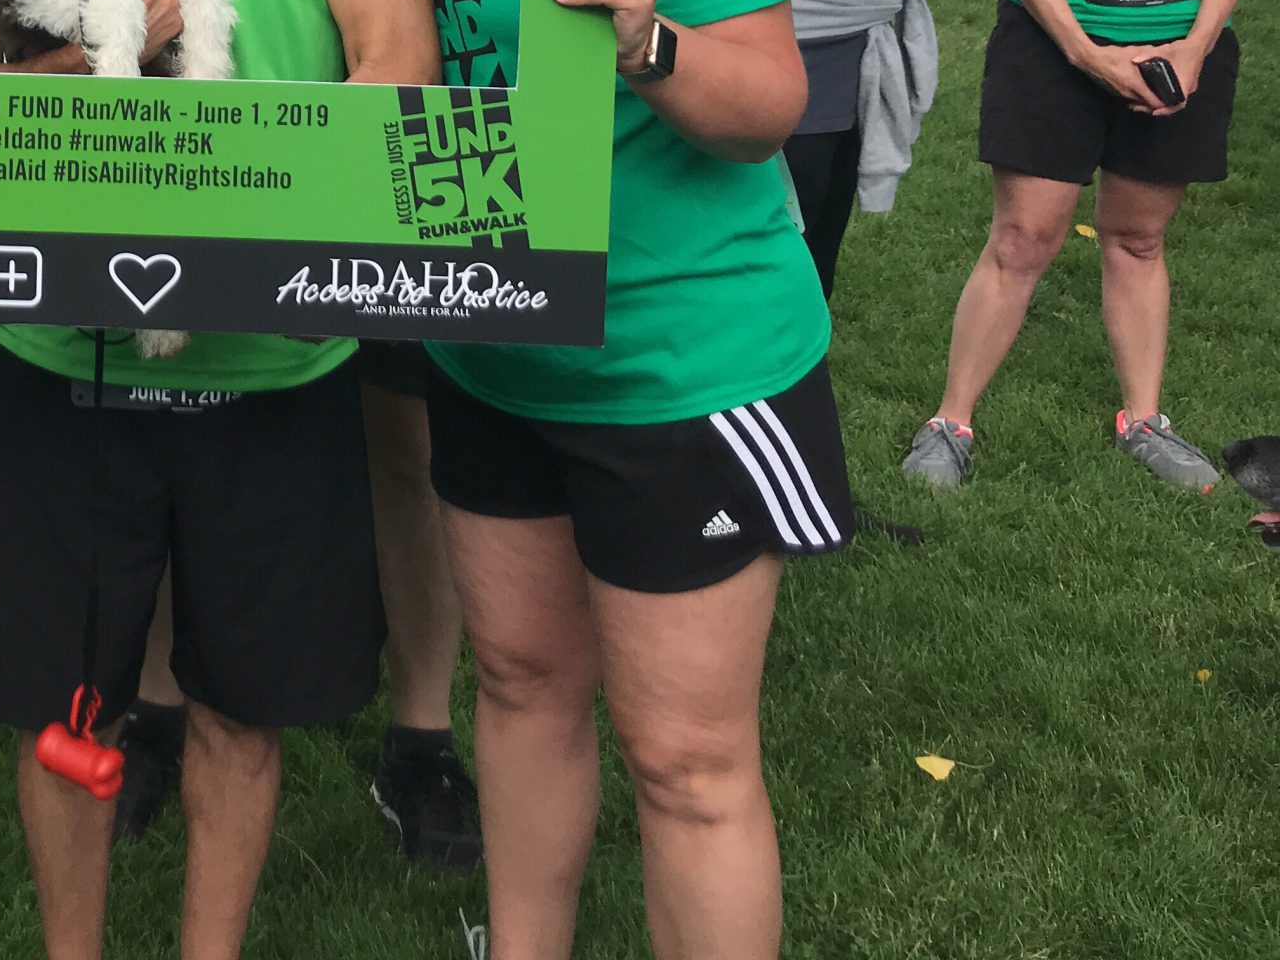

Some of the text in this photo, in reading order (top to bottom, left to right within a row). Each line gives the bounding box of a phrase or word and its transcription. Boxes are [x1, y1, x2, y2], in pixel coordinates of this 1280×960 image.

[8, 95, 64, 120] FUND
[72, 96, 171, 122] Run/Walk
[195, 100, 242, 125] June
[251, 102, 268, 129] 1,
[276, 102, 330, 128] 2019
[69, 129, 166, 154] #runwalk
[173, 131, 214, 155] #5K
[403, 108, 516, 162] FUND
[53, 159, 292, 191] #DisAbilityRightsIdaho
[383, 121, 413, 225] ACCESS TO JUSTICE
[409, 152, 524, 223] 5K
[418, 212, 527, 240] RUN&WALK
[276, 265, 549, 310] Access to Justice
[329, 257, 501, 298] IDAHO
[702, 522, 740, 537] adidas
